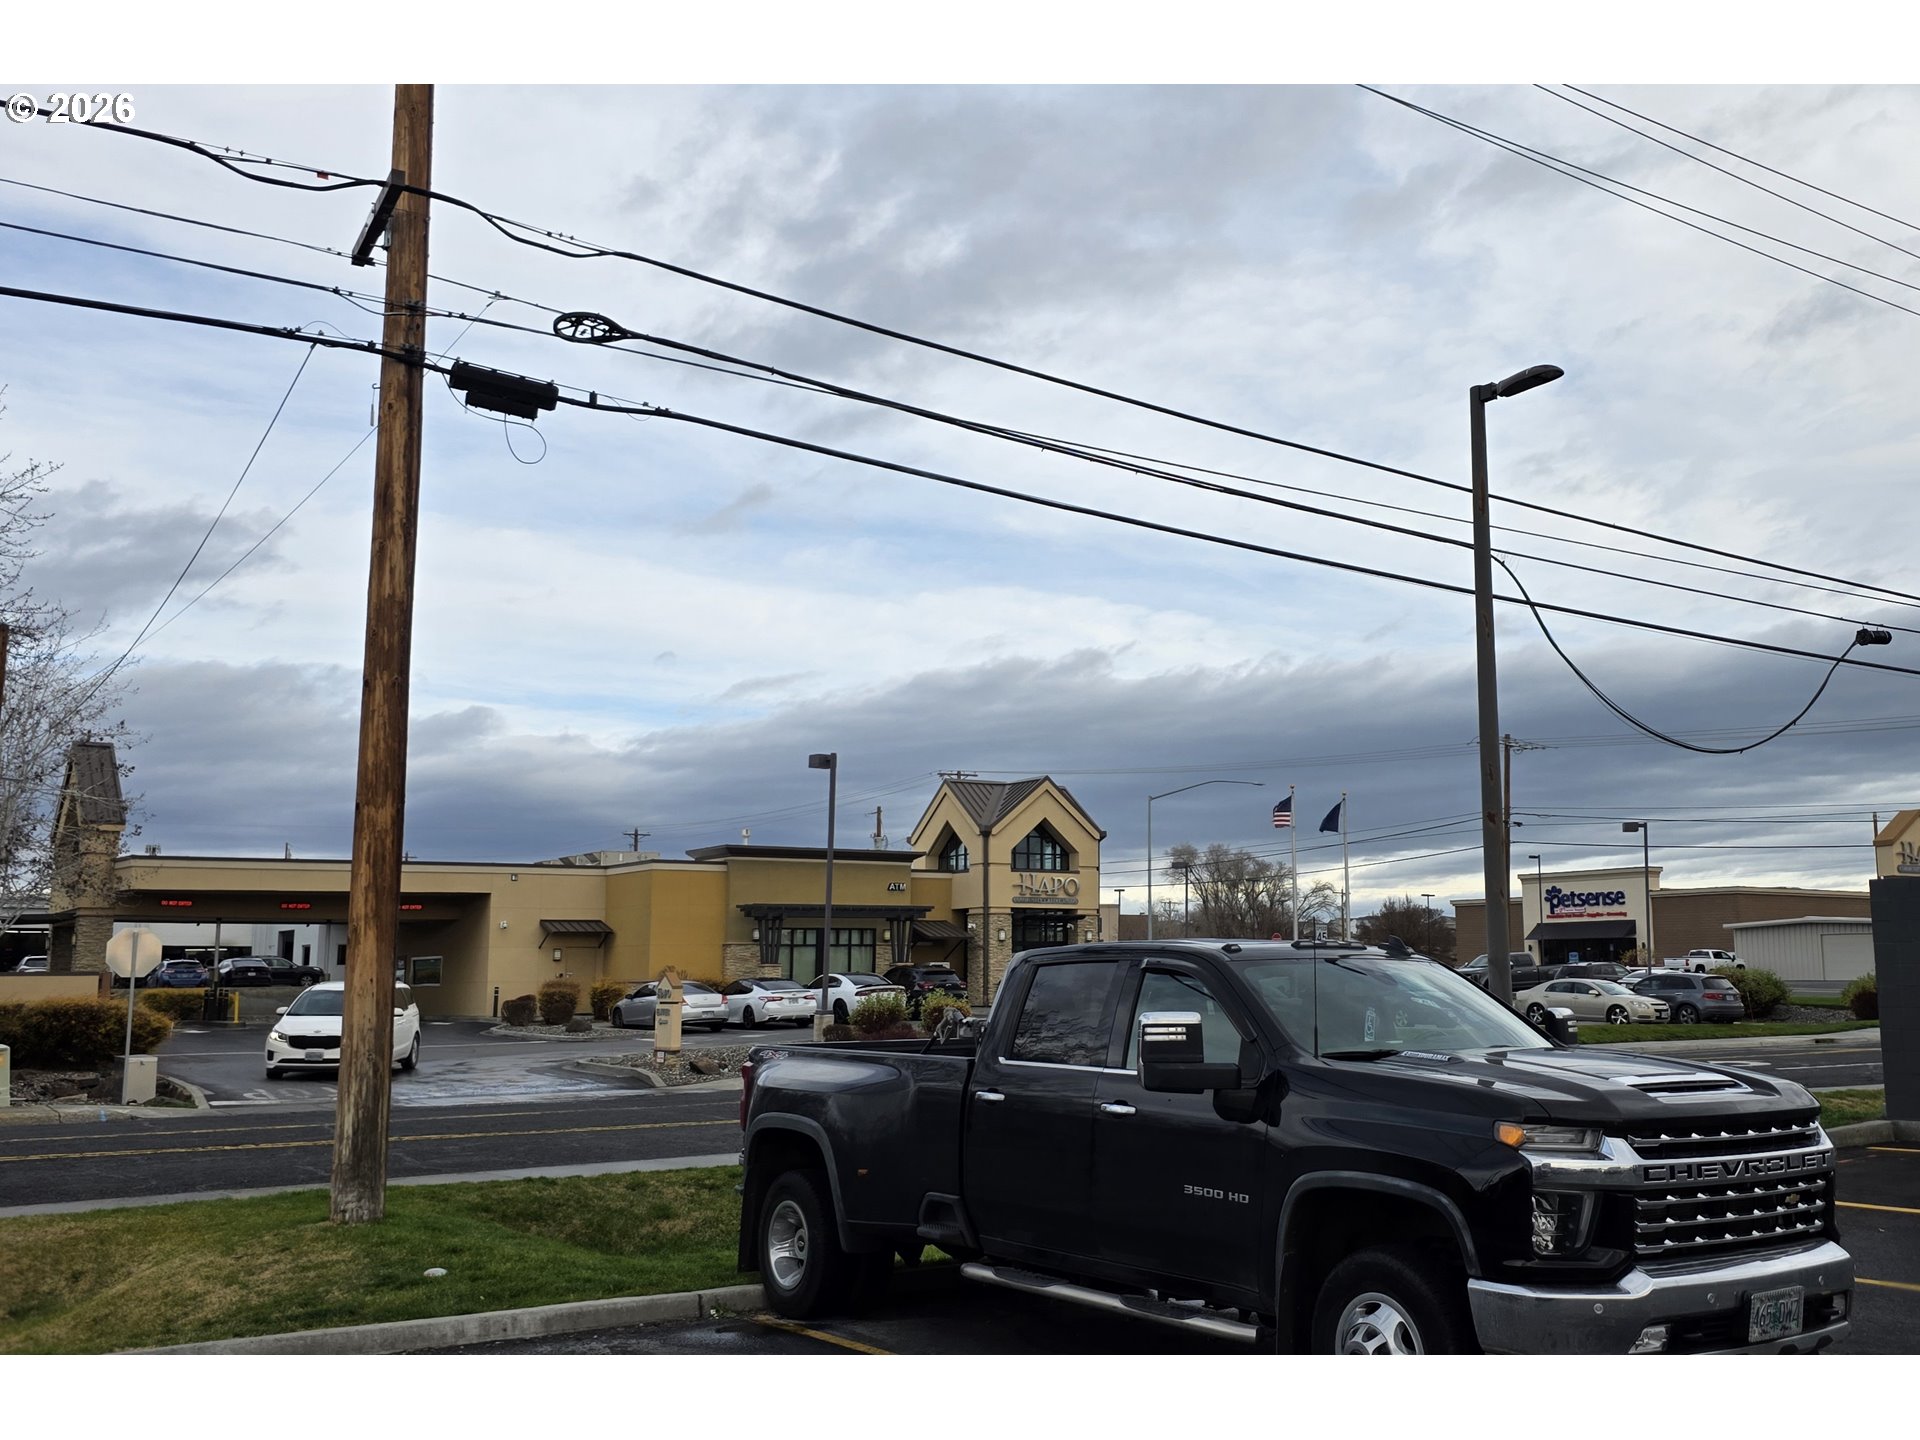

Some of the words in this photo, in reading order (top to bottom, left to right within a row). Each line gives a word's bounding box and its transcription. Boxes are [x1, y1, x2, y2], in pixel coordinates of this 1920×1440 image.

[888, 882, 906, 891] ATM
[1012, 872, 1080, 897] HAPO
[1545, 886, 1626, 914] petsense
[1643, 1151, 1831, 1183] CHEVROLET
[1184, 1184, 1223, 1199] 3500
[1228, 1192, 1249, 1204] HD
